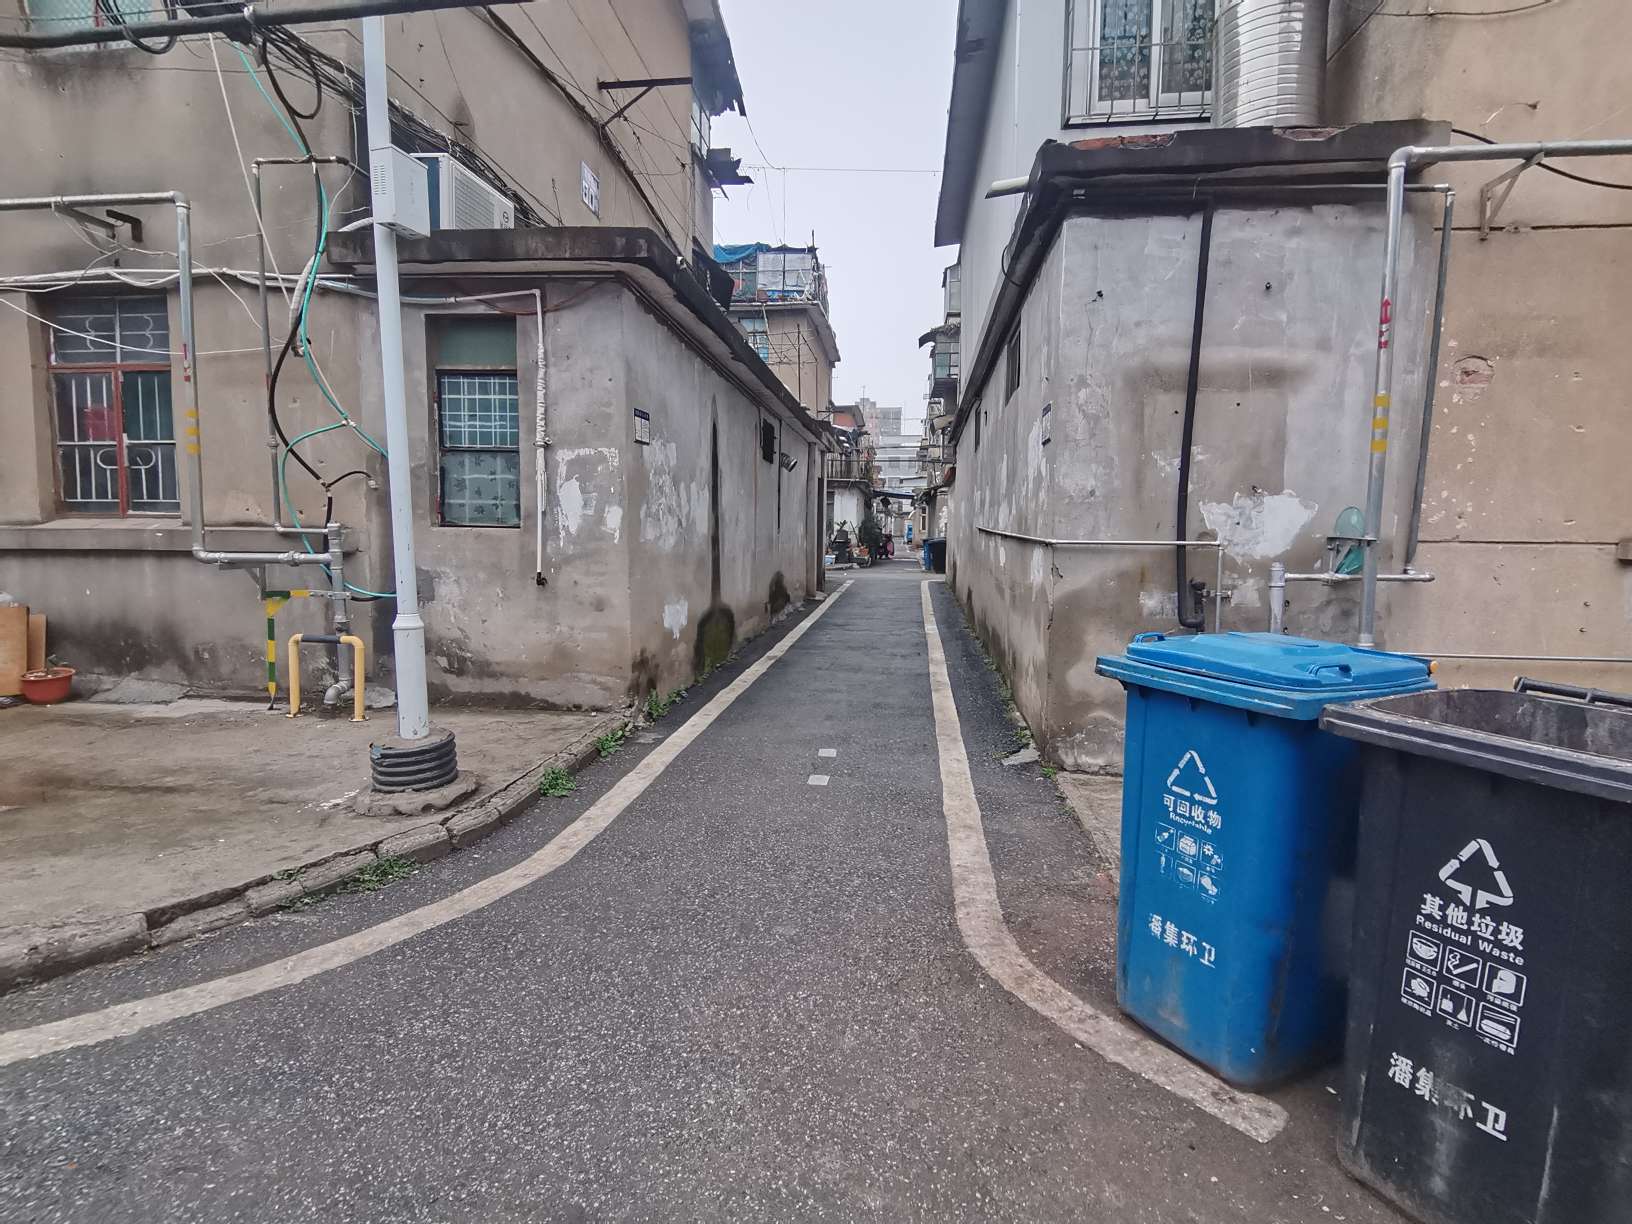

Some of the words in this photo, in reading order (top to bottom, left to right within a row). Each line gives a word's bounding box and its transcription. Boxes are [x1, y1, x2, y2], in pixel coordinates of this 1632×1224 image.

[1163, 793, 1222, 829] 可回收物
[1415, 914, 1472, 946] Residual
[1478, 939, 1525, 966] Waste
[1420, 893, 1524, 951] 其他垃圾
